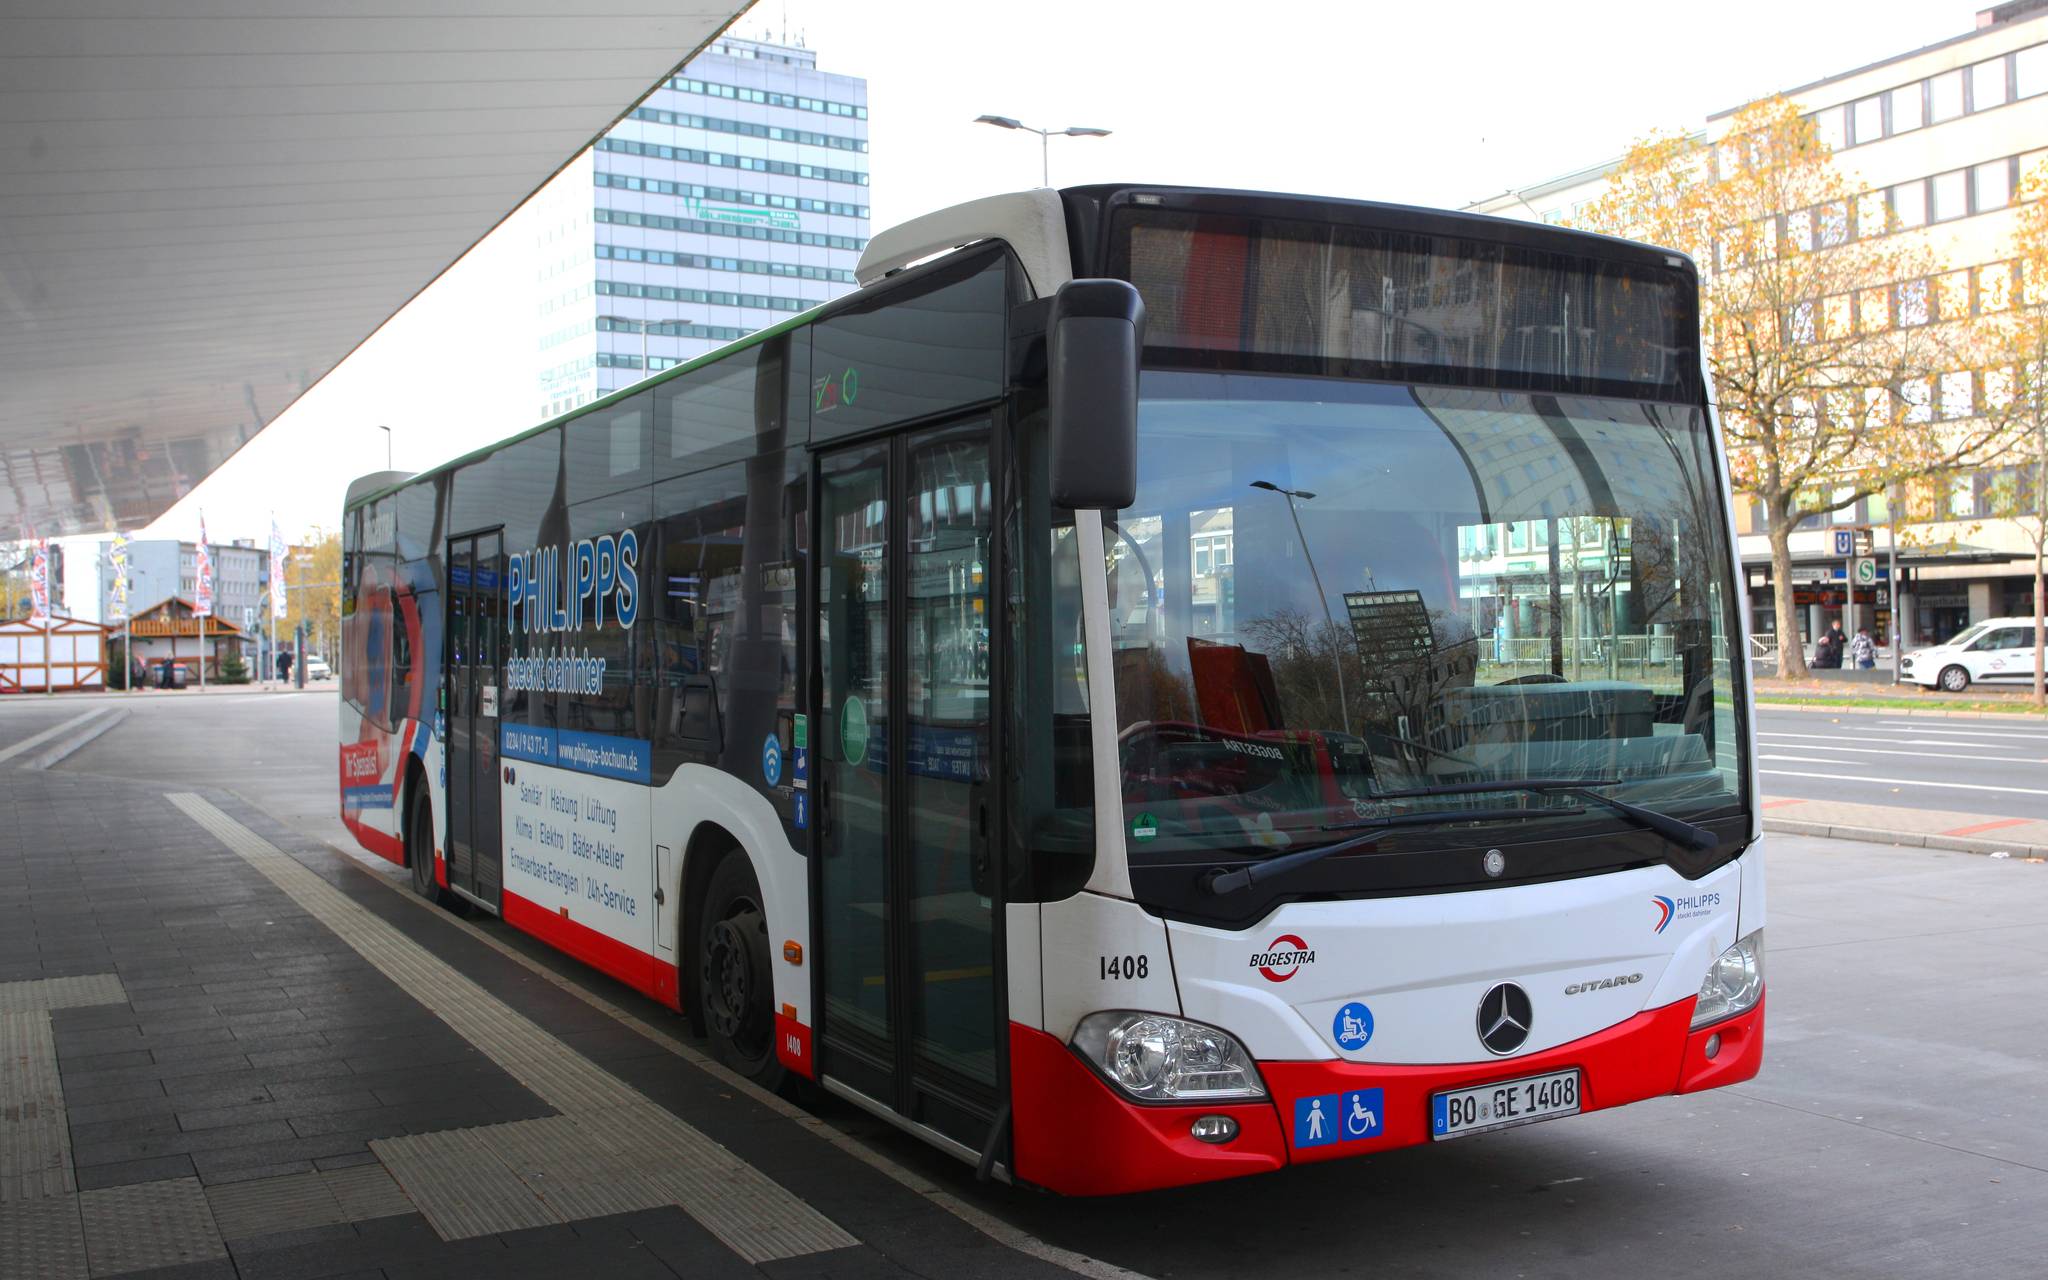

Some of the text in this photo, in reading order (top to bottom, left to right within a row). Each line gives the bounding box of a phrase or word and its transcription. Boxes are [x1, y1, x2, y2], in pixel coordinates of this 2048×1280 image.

[1837, 533, 1849, 553] U
[508, 528, 638, 635] PHILIPPS
[1859, 561, 1874, 582] S
[508, 646, 606, 696] steckt dahinter
[559, 742, 638, 772] www.philipps-bochum.de
[520, 781, 616, 832] Sanitär Heizung Lüftung
[1141, 814, 1150, 828] 4
[515, 815, 624, 870] Klima Elektro Bäder-Atelier
[511, 847, 635, 916] Erneuerbare Energien 24h-Service
[1677, 893, 1720, 910] PHILIPPS
[1100, 954, 1149, 980] 1408
[1249, 950, 1315, 967] BOGESTRA
[1565, 973, 1644, 995] CITARO
[786, 1033, 802, 1057] 1408
[1450, 1095, 1477, 1128] BO
[1493, 1087, 1519, 1119] GE
[1525, 1077, 1575, 1113] 1408
